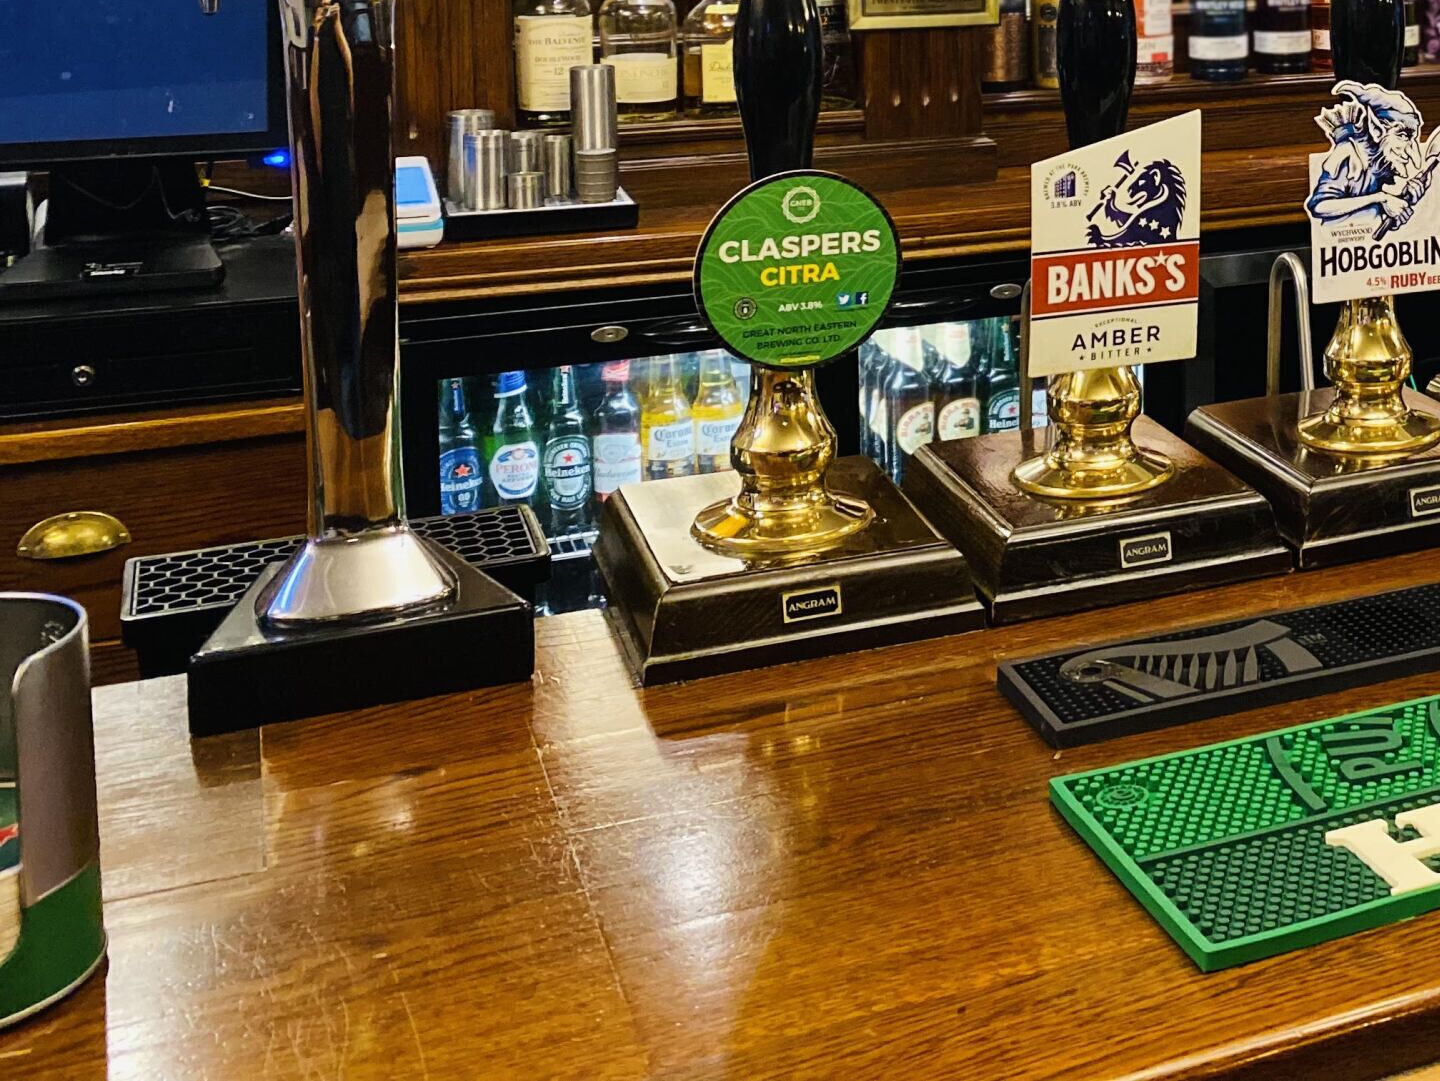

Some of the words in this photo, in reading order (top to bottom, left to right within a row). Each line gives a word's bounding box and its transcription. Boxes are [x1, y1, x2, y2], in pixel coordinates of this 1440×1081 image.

[1330, 227, 1374, 239] WYCHWOOD
[1338, 235, 1366, 244] BREWERY
[717, 228, 881, 264] CLASPERS
[760, 262, 841, 288] CITRA
[1390, 272, 1427, 289] RUBY
[778, 302, 799, 313] ABV
[743, 328, 775, 339] GREAT
[777, 324, 812, 336] NORTH
[813, 320, 857, 332] EASTERN
[1094, 317, 1139, 328] EXCEPTIONAL
[757, 338, 804, 350] BREWING
[1071, 324, 1161, 352] AMBER
[1090, 346, 1141, 361] BITTER
[1126, 543, 1167, 558] ANGRAM
[788, 596, 836, 613] ANGRAM
